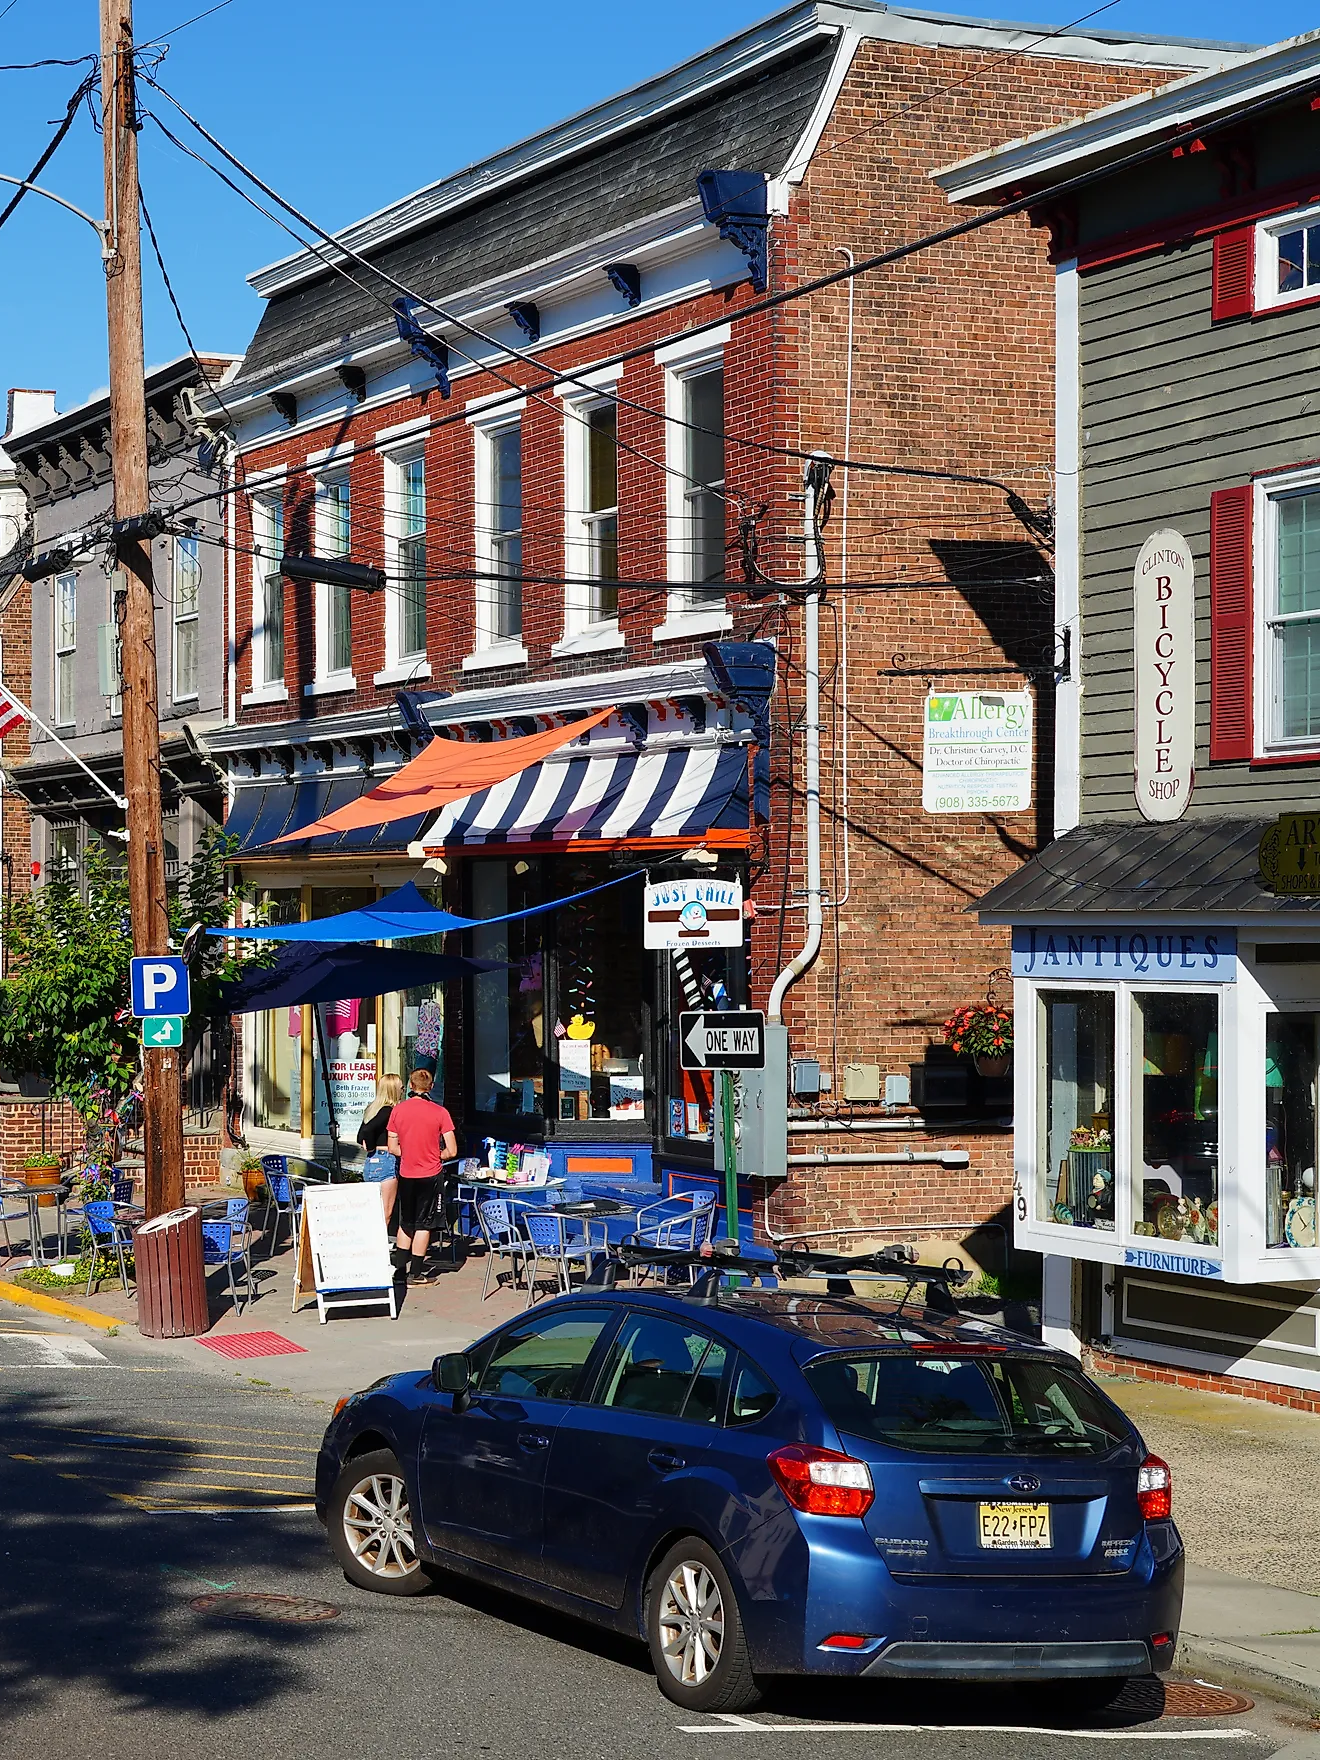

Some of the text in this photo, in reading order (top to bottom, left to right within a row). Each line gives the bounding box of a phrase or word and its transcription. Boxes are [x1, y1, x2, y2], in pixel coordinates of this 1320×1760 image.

[1142, 549, 1185, 575] CLINTON
[1153, 576, 1176, 773] BICYCLE
[953, 696, 1029, 729] Allergy
[928, 726, 1029, 742] Breakthrough Center
[929, 746, 942, 755] Dr.
[944, 746, 978, 755] Christine
[1010, 744, 1028, 753] D.C.
[936, 756, 1021, 768] Doctor of Chiropractic
[1149, 778, 1180, 800] SHOP
[935, 795, 1020, 810] (908) 335-5673
[1282, 874, 1308, 890] SHOPS
[652, 881, 736, 907] JUST CHILL
[1024, 928, 1219, 973] JANTIQUES
[142, 963, 177, 1010] P
[706, 1030, 756, 1052] ONE WAY
[329, 1062, 376, 1071] FOR LEASE
[1137, 1250, 1208, 1276] FURNITURE
[996, 1504, 1033, 1514] New Jersey
[874, 1537, 929, 1546] SUBARU
